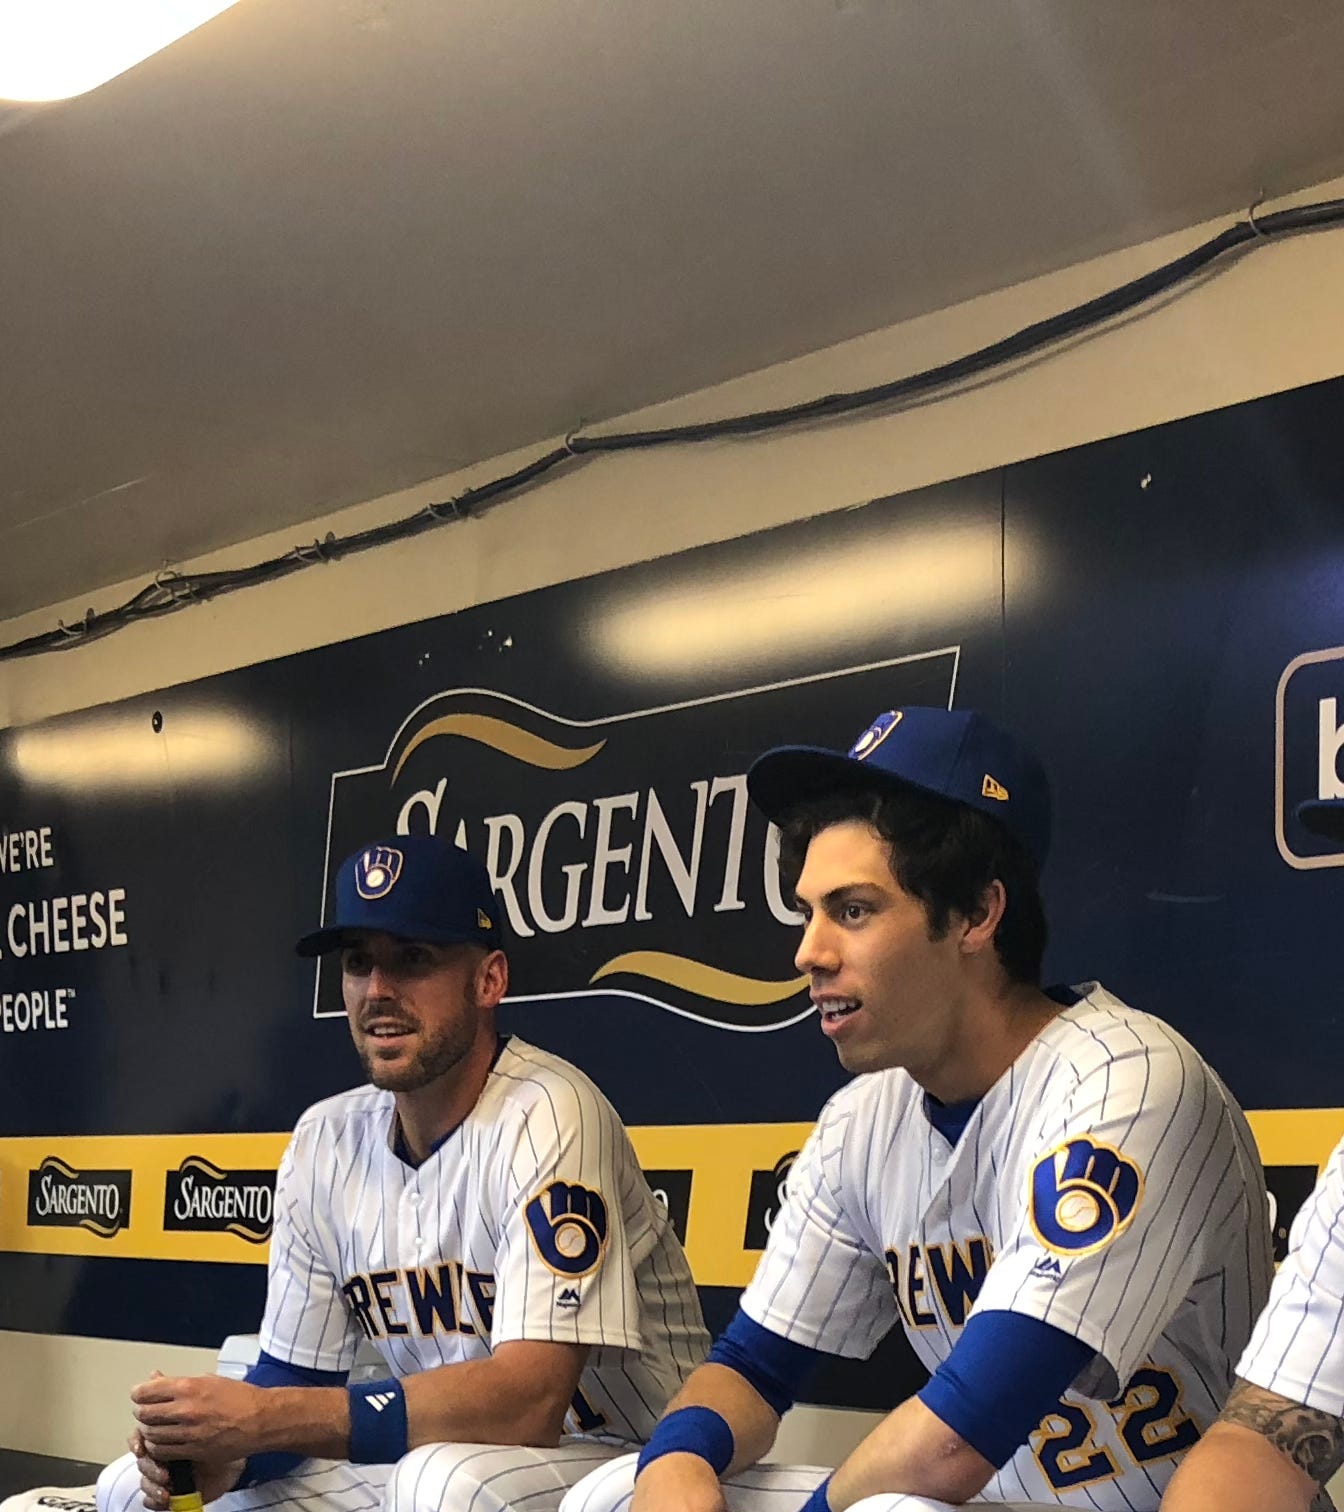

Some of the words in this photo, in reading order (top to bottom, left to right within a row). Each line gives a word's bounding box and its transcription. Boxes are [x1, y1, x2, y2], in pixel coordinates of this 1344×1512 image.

[7, 887, 128, 958] CHEESE
[35, 1174, 120, 1220] SARGENTO
[174, 1176, 272, 1223] SARGENTO
[1027, 1362, 1205, 1497] 22
